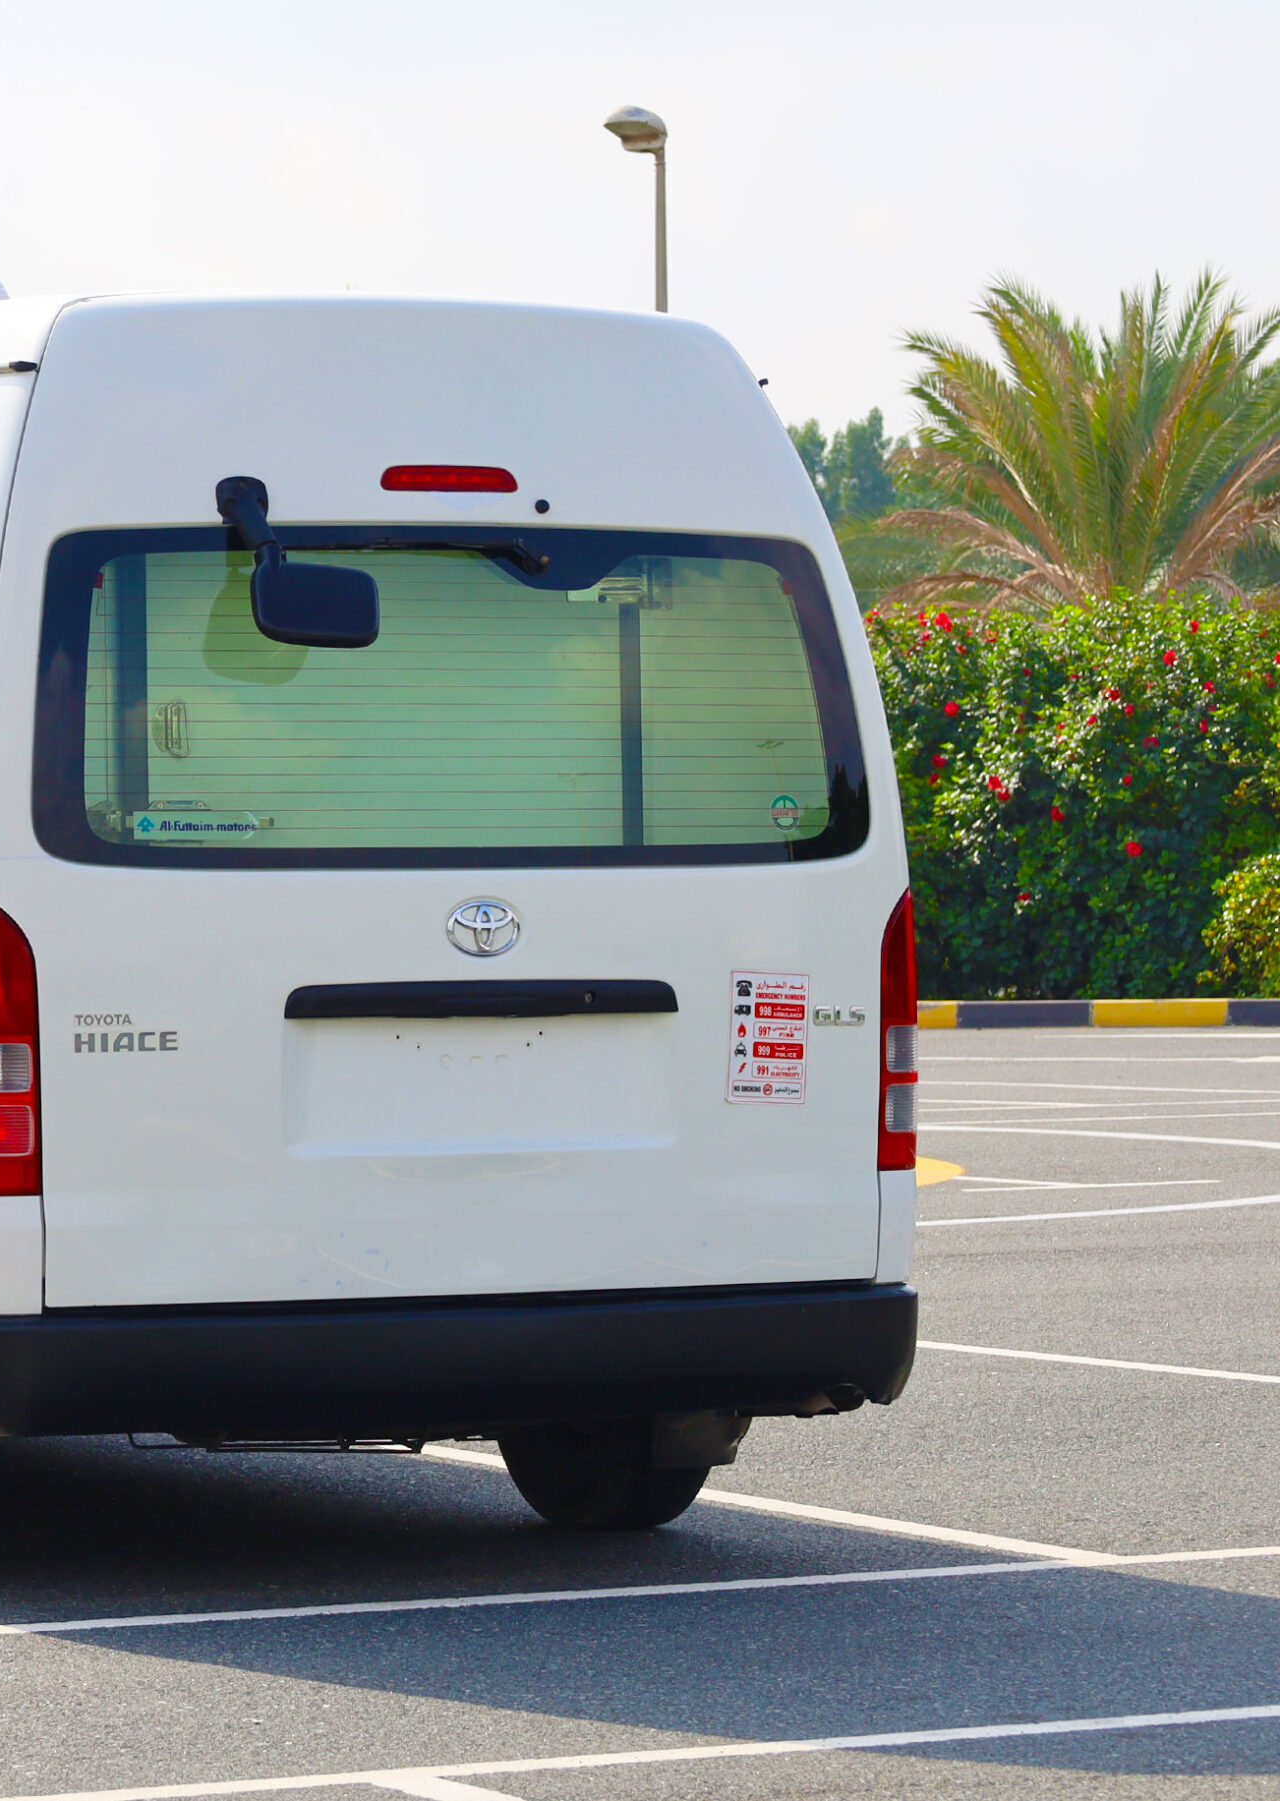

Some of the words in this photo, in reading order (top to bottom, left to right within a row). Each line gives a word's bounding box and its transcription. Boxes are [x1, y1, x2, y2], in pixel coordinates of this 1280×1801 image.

[216, 822, 258, 832] motors
[759, 1006, 772, 1016] 998
[813, 1004, 866, 1026] GLS
[74, 1014, 132, 1026] TOYOTA
[758, 1026, 771, 1036] 997
[74, 1031, 178, 1053] HIACE
[757, 1045, 771, 1056] 999
[756, 1065, 769, 1076] 991
